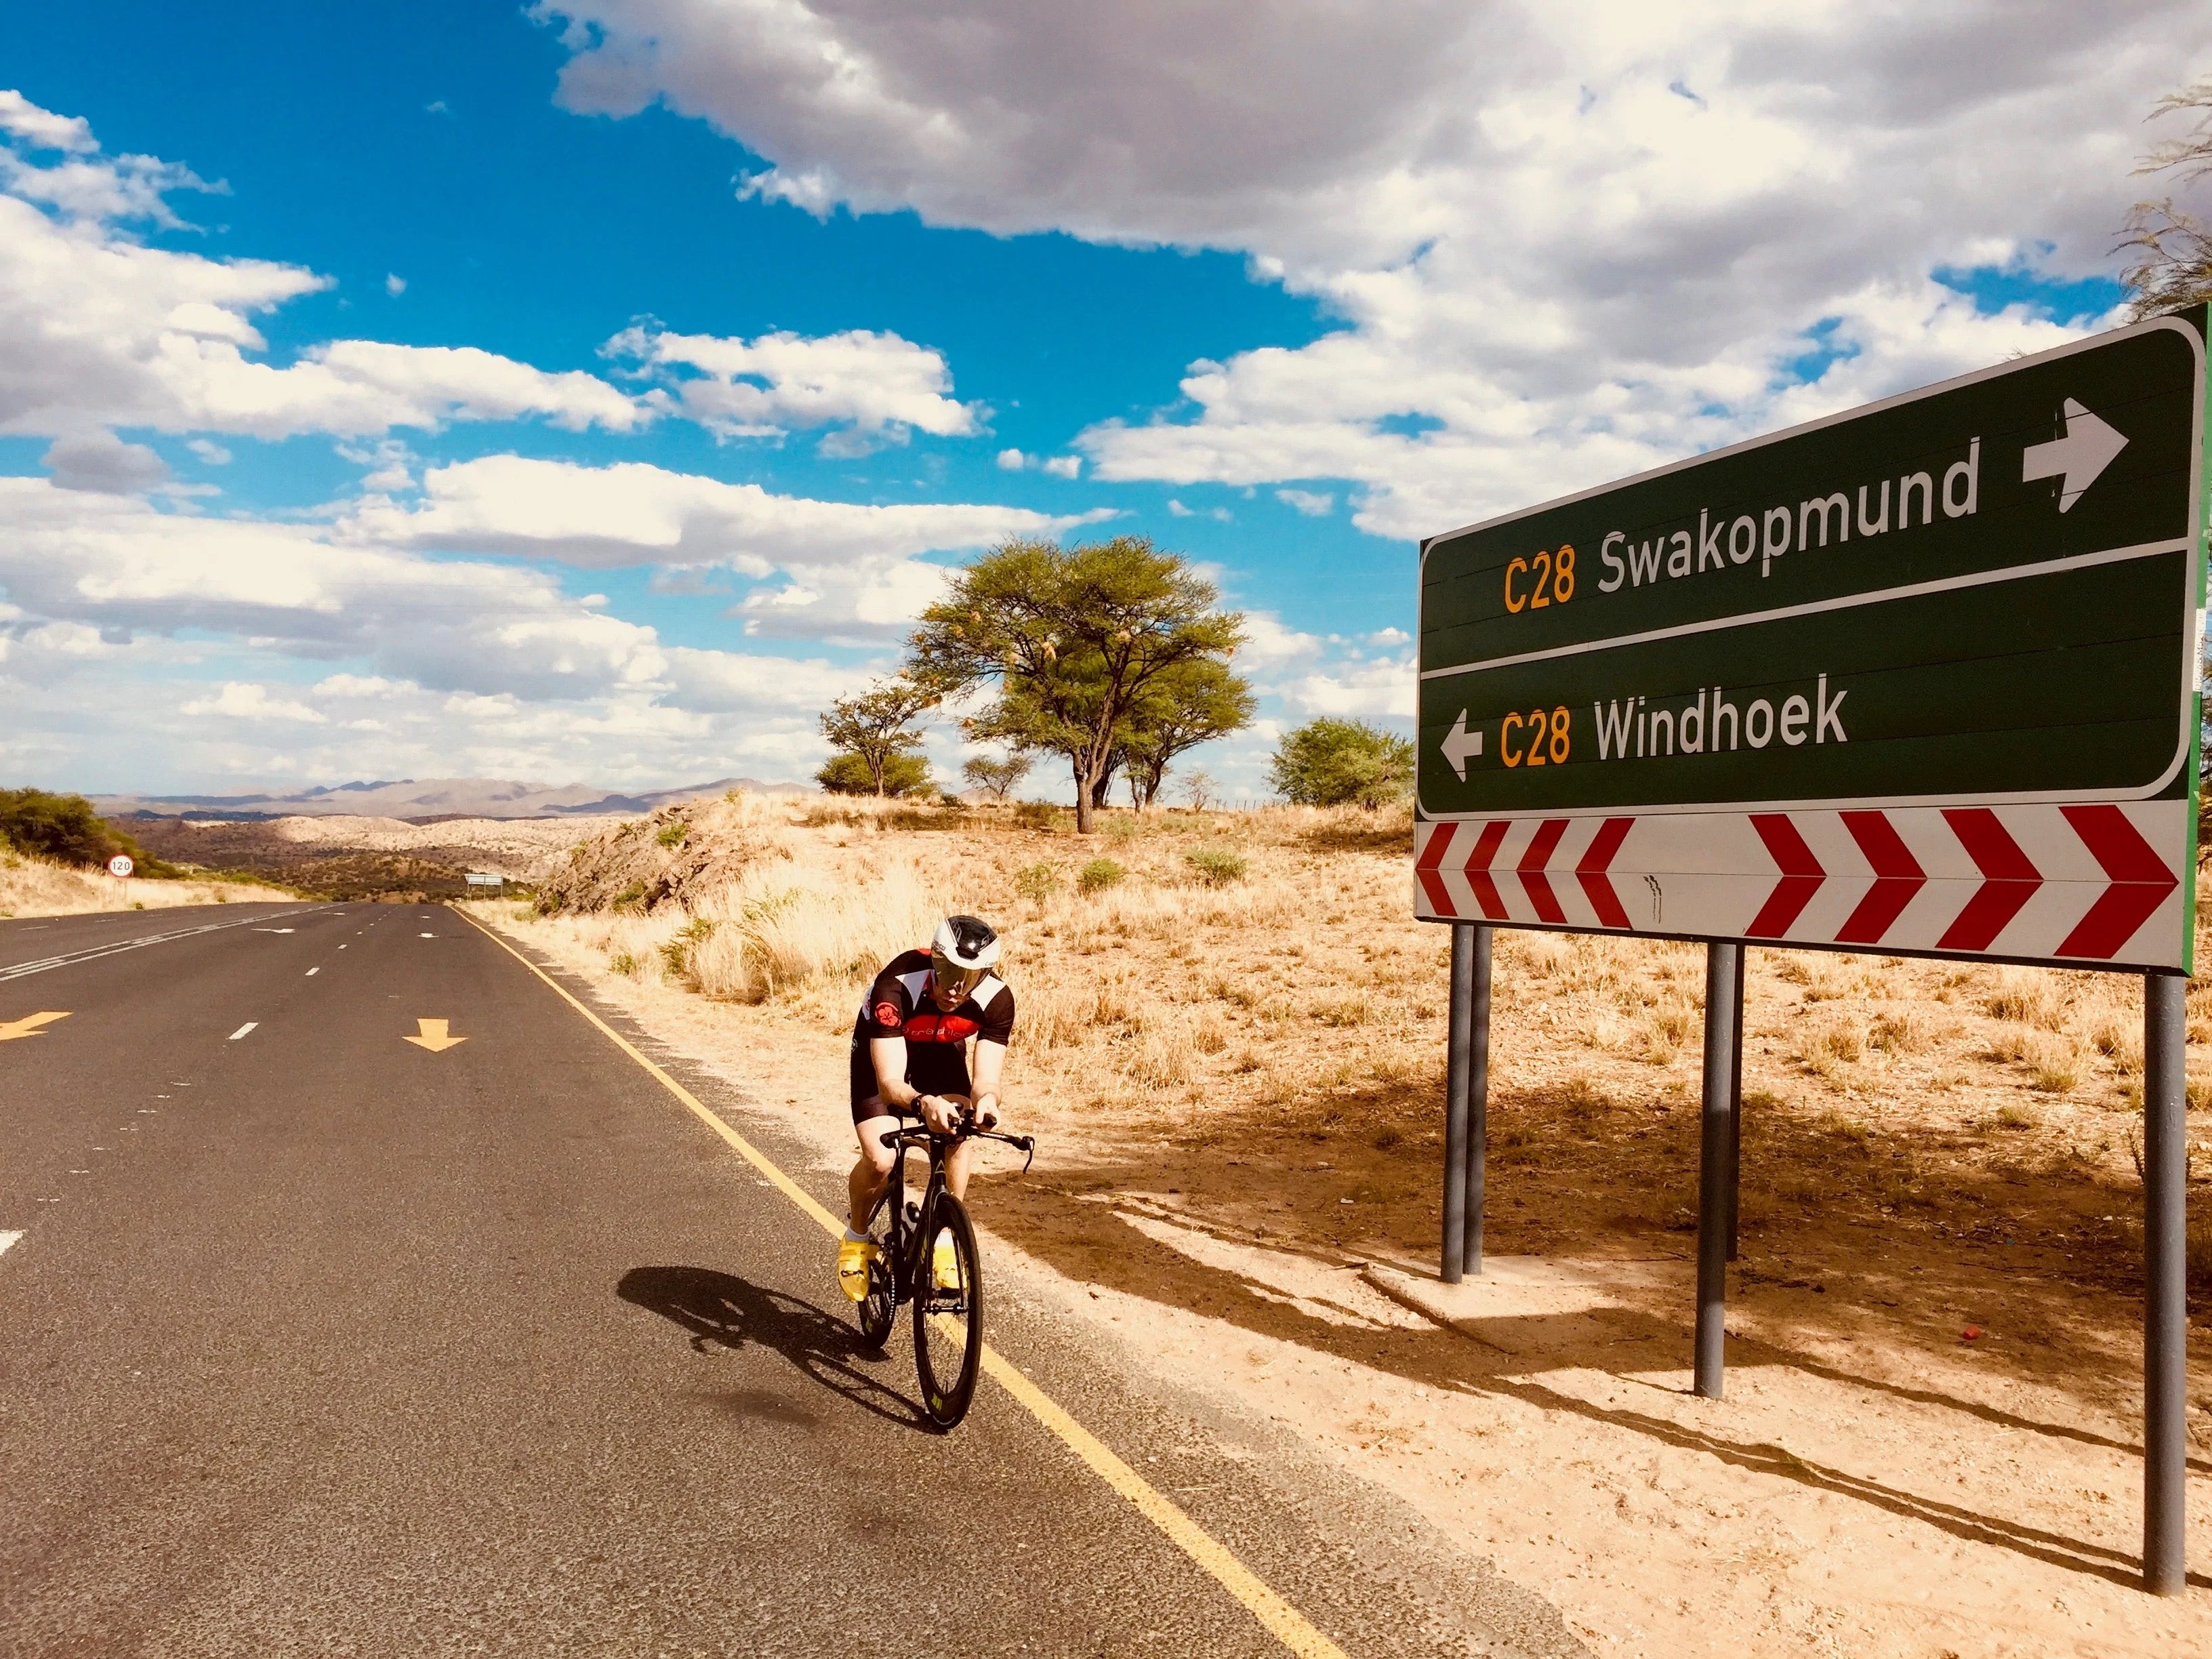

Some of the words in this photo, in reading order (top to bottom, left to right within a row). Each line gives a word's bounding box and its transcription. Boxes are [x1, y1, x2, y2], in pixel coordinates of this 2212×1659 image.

[1504, 544, 1575, 613] C28
[1597, 436, 1980, 592] Swakopmund
[1501, 705, 1570, 767] C28
[1594, 673, 1848, 760] Windhoek
[112, 861, 130, 870] 120
